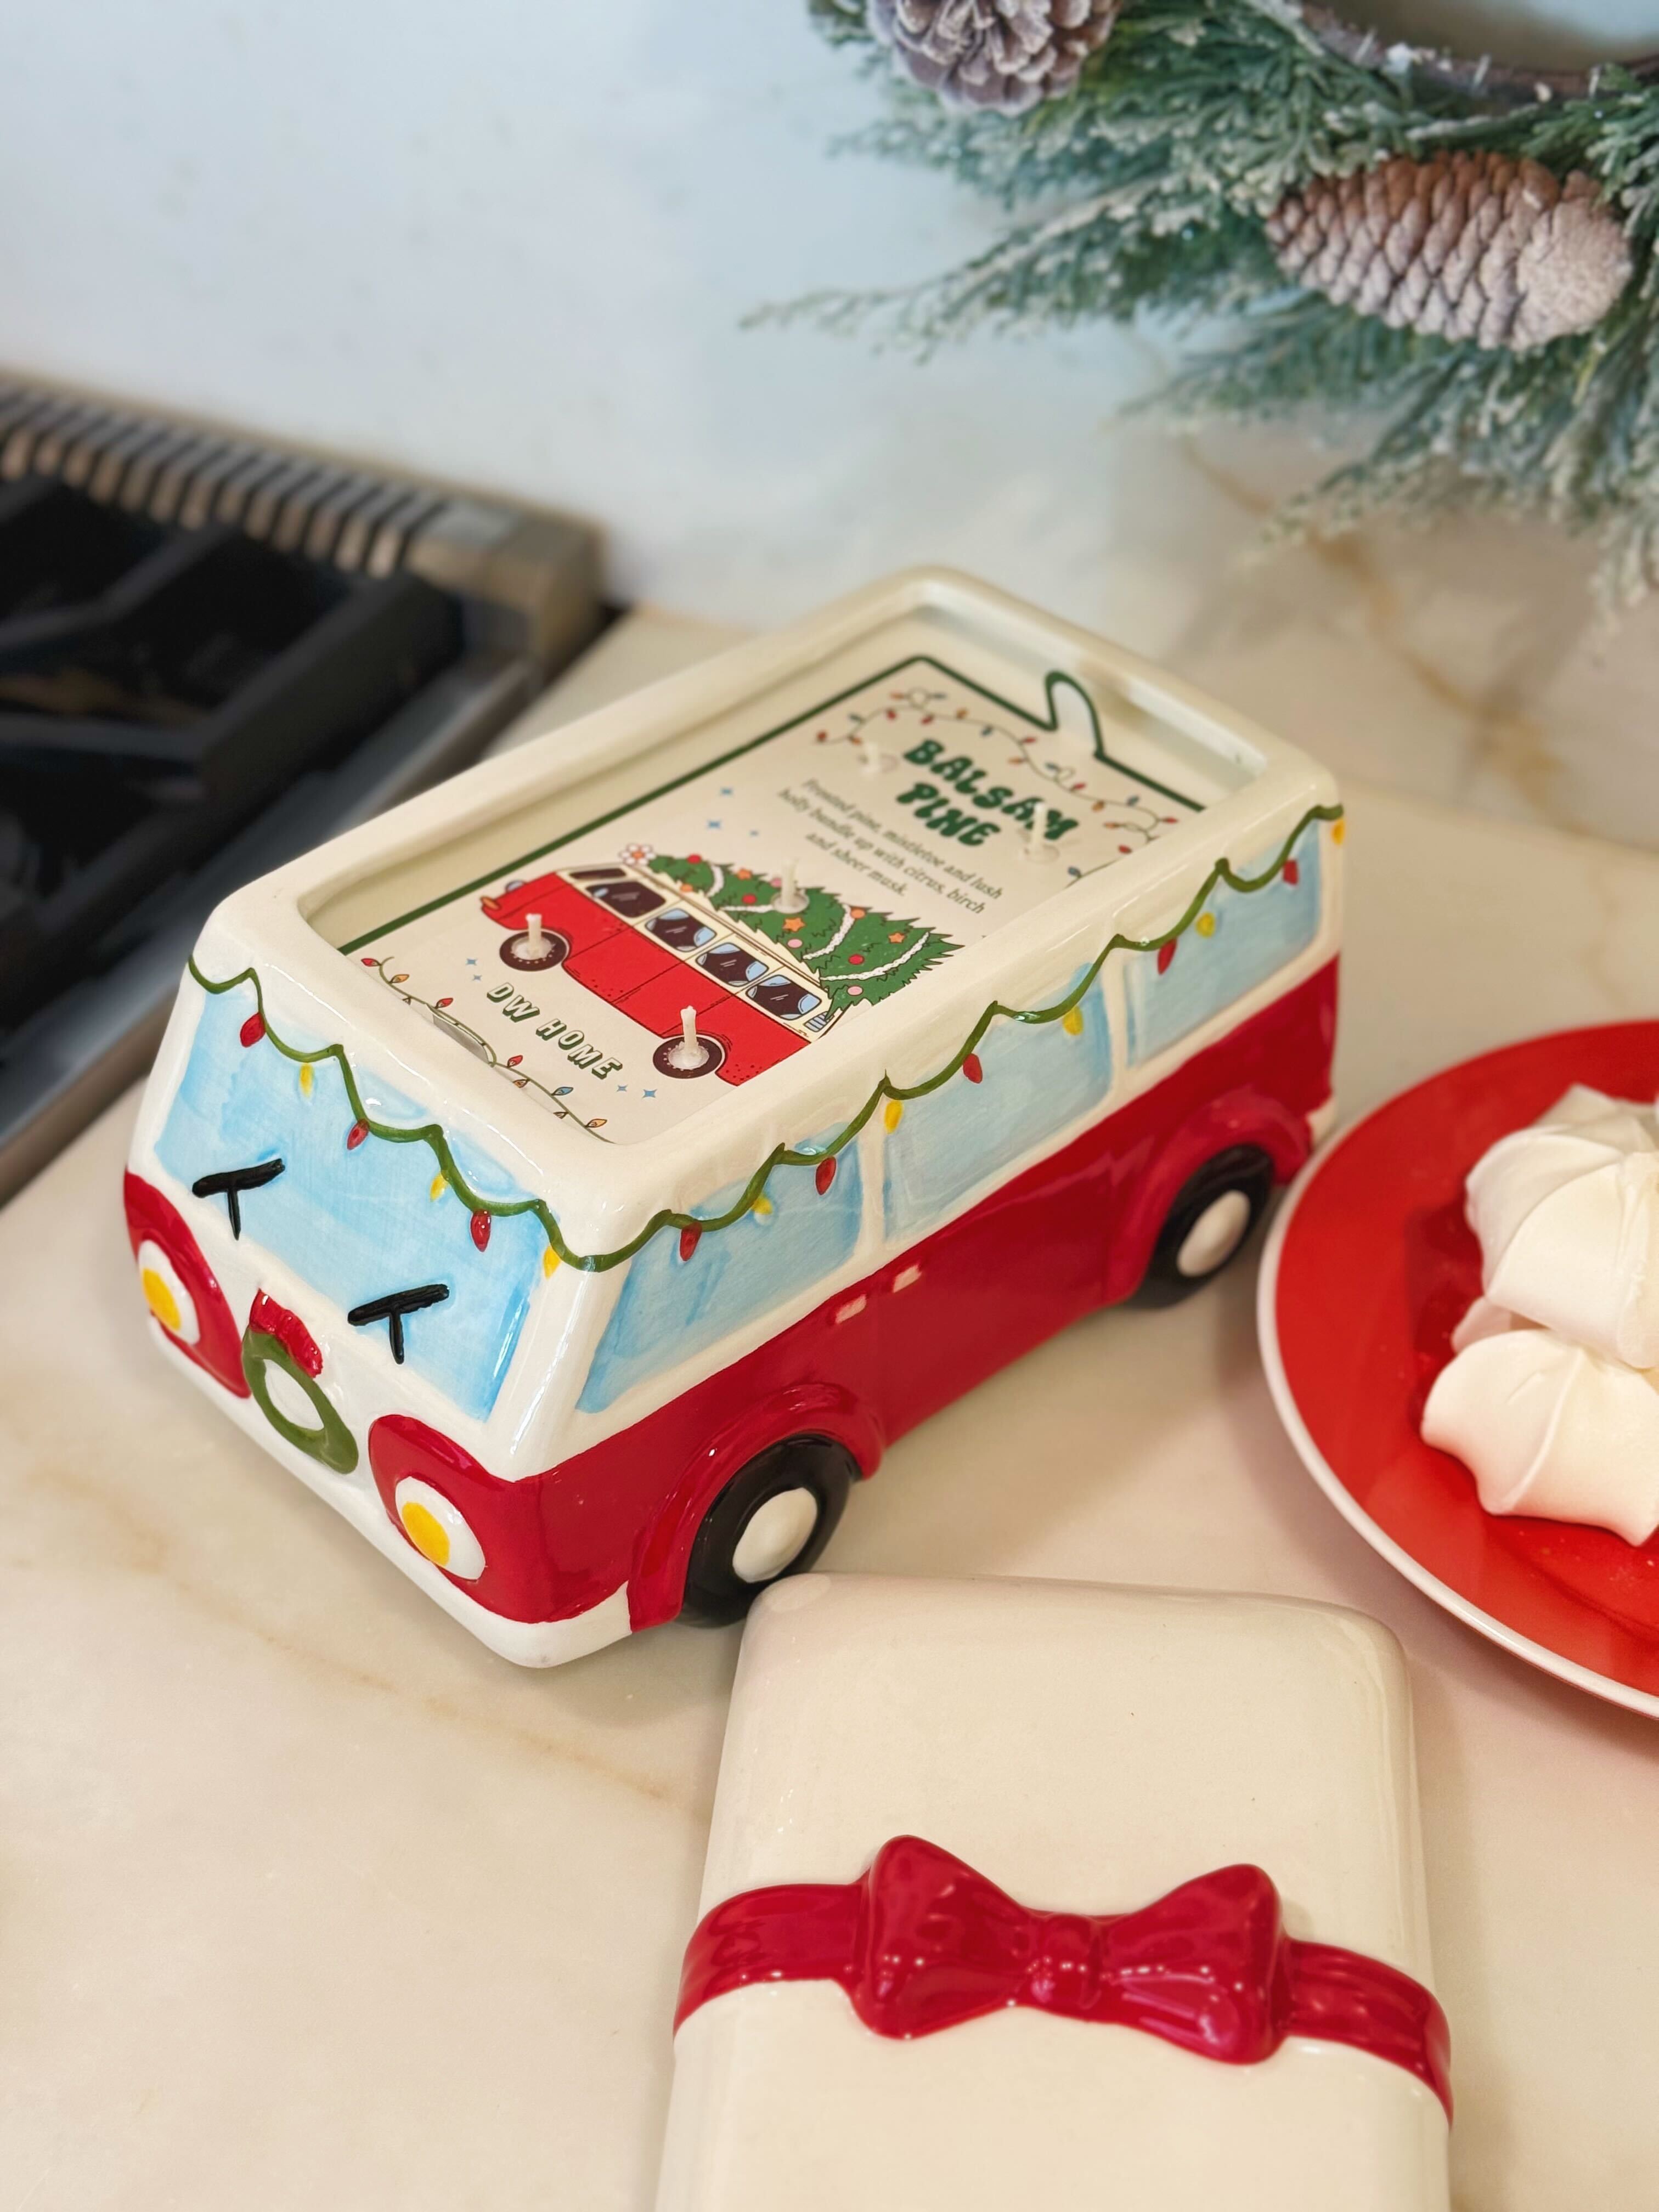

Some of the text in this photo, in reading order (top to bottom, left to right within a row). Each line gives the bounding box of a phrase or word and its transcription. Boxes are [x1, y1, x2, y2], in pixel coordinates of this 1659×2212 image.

[896, 783, 1001, 846] PINE
[778, 788, 809, 812] holly
[809, 806, 854, 839] bundle
[854, 836, 874, 850] up
[873, 848, 905, 869] with
[946, 888, 986, 915] birch
[805, 832, 838, 850] and
[831, 848, 871, 872] sheer
[884, 831, 945, 867] mistletoe
[944, 865, 976, 882] and
[969, 877, 1003, 900] lush
[486, 982, 623, 1080] DW HOME
